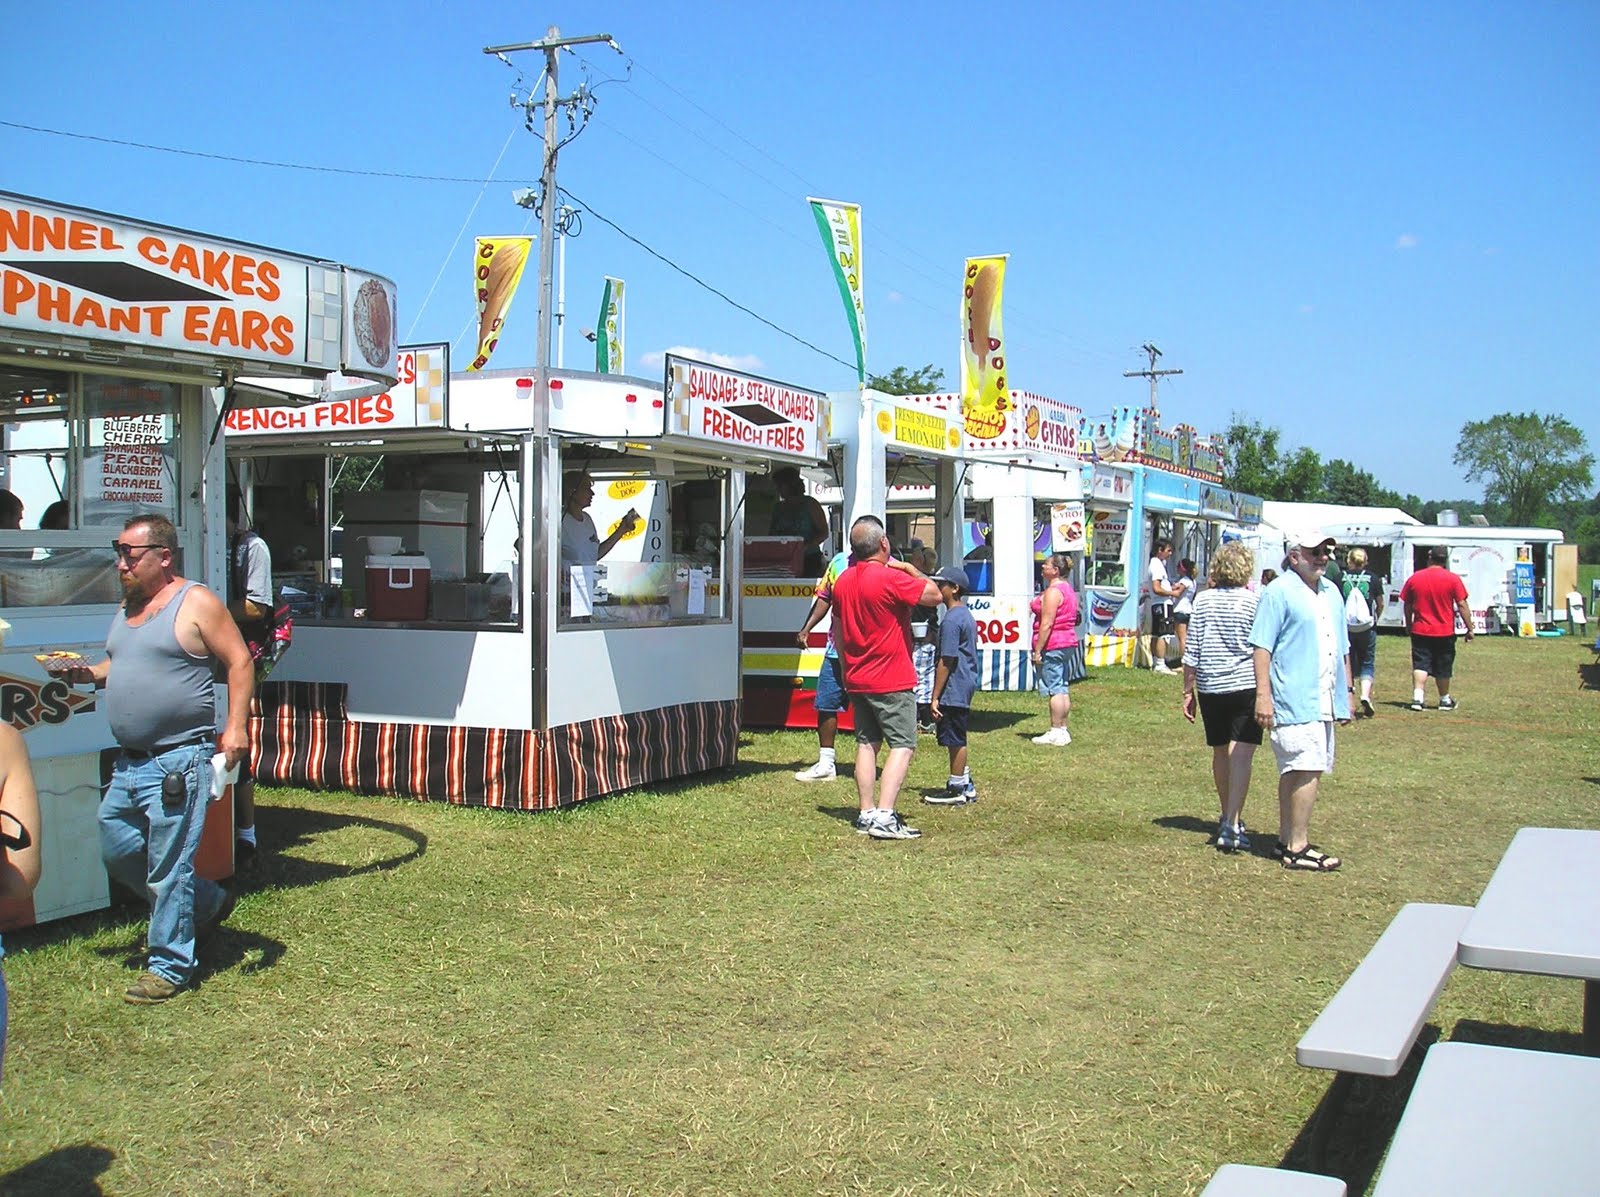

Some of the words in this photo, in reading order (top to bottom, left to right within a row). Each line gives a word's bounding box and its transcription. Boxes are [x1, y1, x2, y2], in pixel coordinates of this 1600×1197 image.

[0, 208, 124, 252] NNEL
[137, 236, 280, 302] CAKES
[3, 269, 171, 337] PHANT
[184, 306, 294, 356] EARS
[988, 337, 1008, 411] DOGS
[690, 368, 738, 403] SAUSAGE
[740, 383, 745, 397] &
[746, 381, 775, 411] STEAK
[777, 388, 815, 423] HOAGIES
[225, 406, 306, 431] RENCH
[315, 393, 394, 427] FRIES
[103, 421, 162, 434] BLUEBERRY
[103, 431, 162, 444] CHERRY
[703, 406, 763, 445] FRENCH
[767, 425, 805, 452] FRIES
[895, 425, 946, 451] LEMONADE
[1041, 420, 1075, 448] GYROS
[103, 453, 162, 466] PEACH
[103, 464, 162, 477] BLACKBERRY
[103, 477, 162, 490] CARAMEL
[620, 484, 636, 498] DOG
[745, 586, 782, 597] SLAW
[976, 619, 1020, 644] ROS
[1, 680, 72, 726] RS
